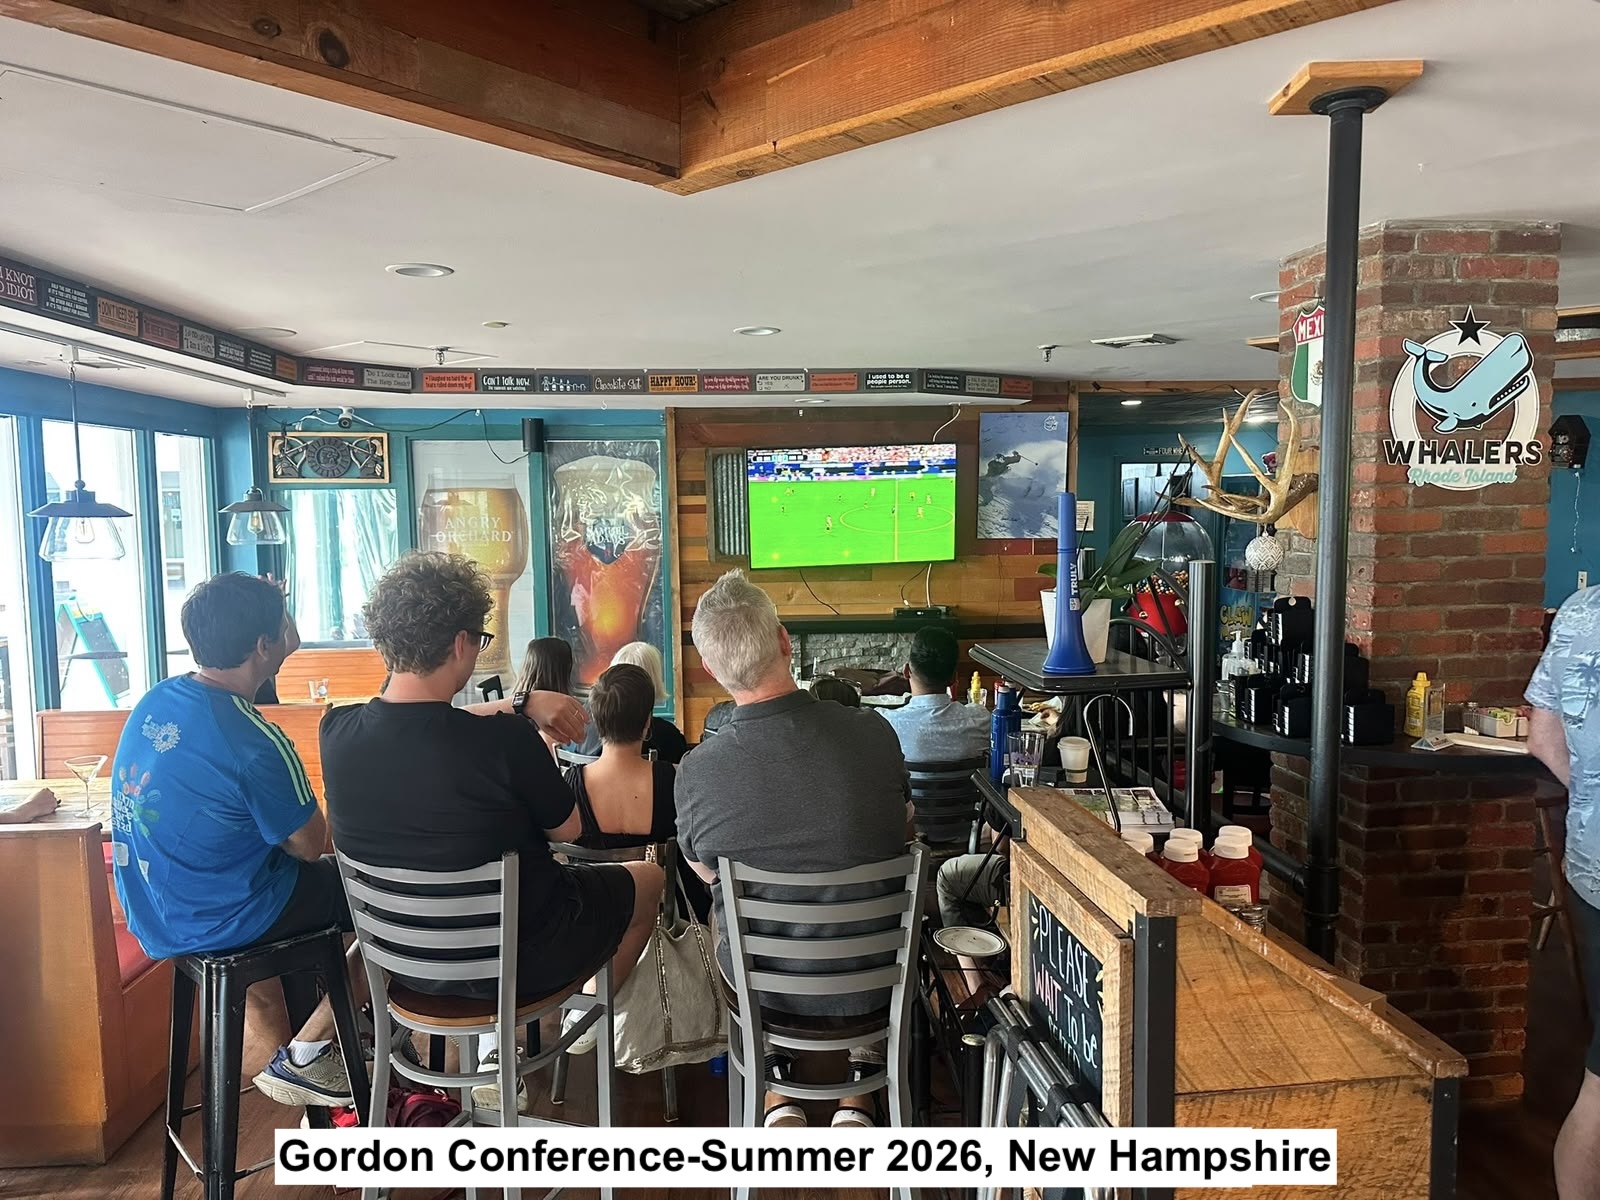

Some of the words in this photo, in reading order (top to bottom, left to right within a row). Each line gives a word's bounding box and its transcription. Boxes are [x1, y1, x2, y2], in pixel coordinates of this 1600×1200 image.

[5, 268, 35, 287] KNOT
[7, 283, 35, 301] IDIOT
[1298, 314, 1324, 342] MEXI
[483, 376, 499, 385] Can't
[650, 376, 672, 386] HAPPY
[1384, 440, 1542, 465] WHALERS
[1408, 468, 1461, 484] Rhode
[1464, 468, 1515, 484] Island
[445, 517, 500, 530] ANGRY
[436, 531, 512, 543] ORCHARD
[1070, 563, 1078, 596] TRULY
[1220, 605, 1253, 627] CLAW
[1039, 905, 1089, 1008] PLEASE
[1033, 954, 1061, 1021] WAIT
[1082, 1013, 1097, 1069] be
